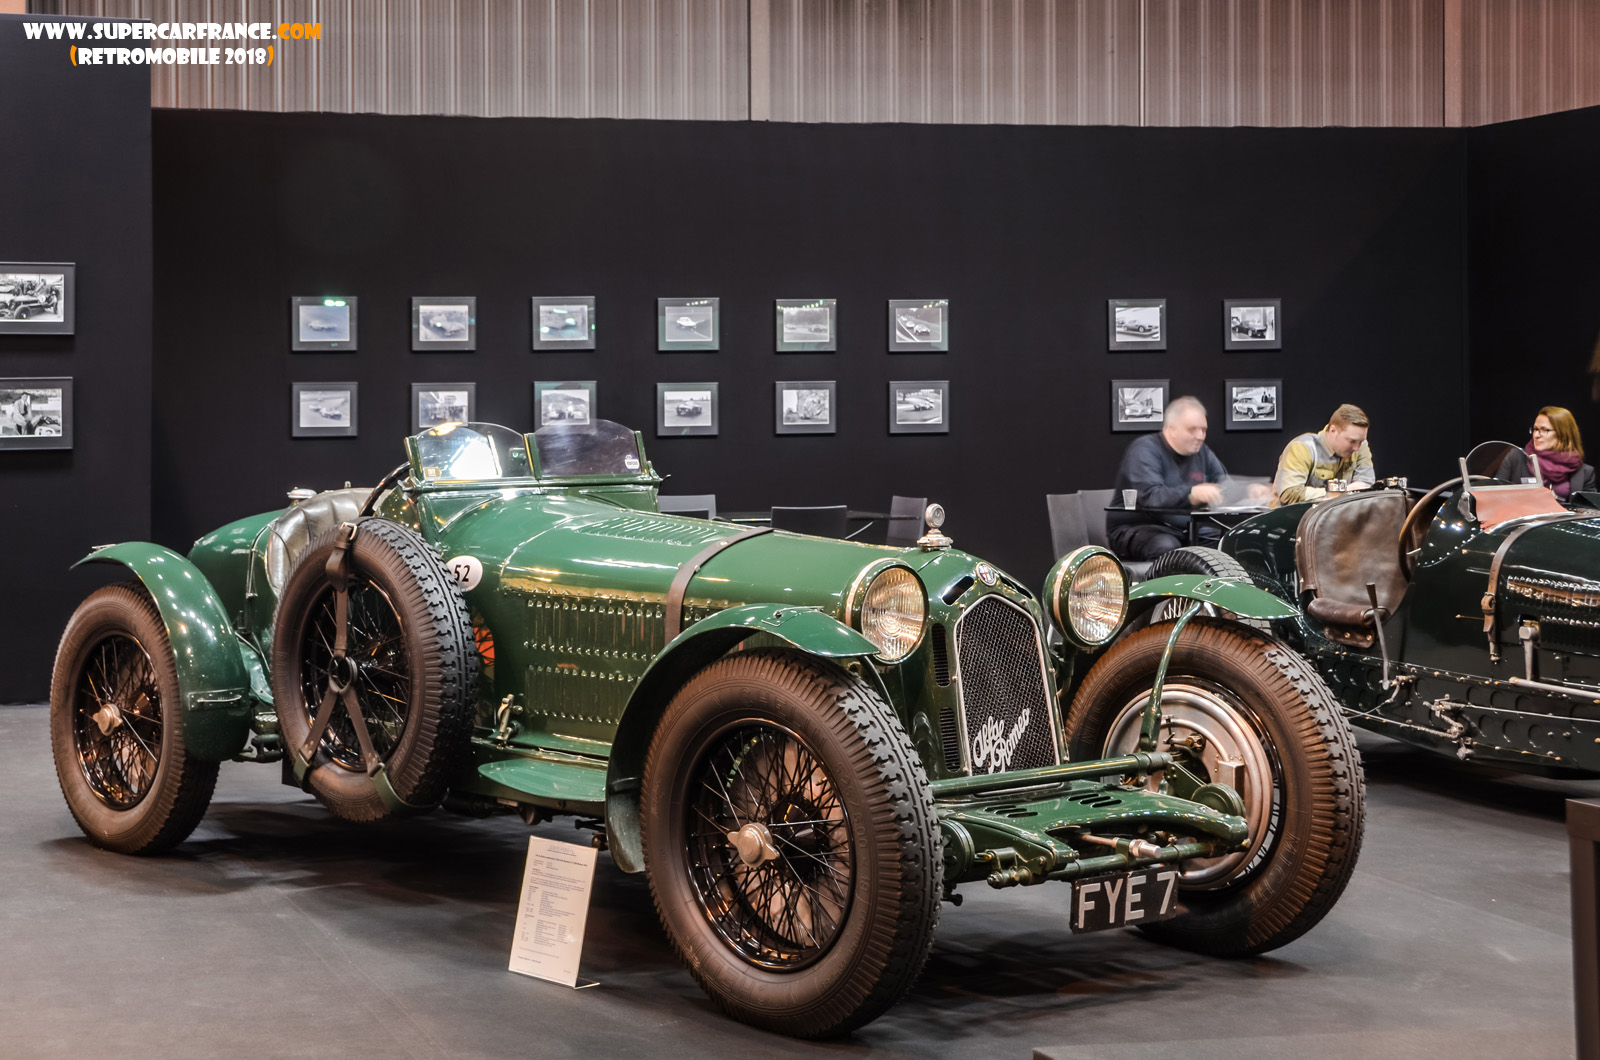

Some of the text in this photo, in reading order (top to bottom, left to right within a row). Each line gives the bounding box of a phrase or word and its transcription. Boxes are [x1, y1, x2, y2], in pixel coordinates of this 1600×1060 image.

[453, 564, 471, 583] 52
[1078, 871, 1176, 928] FYE 7
